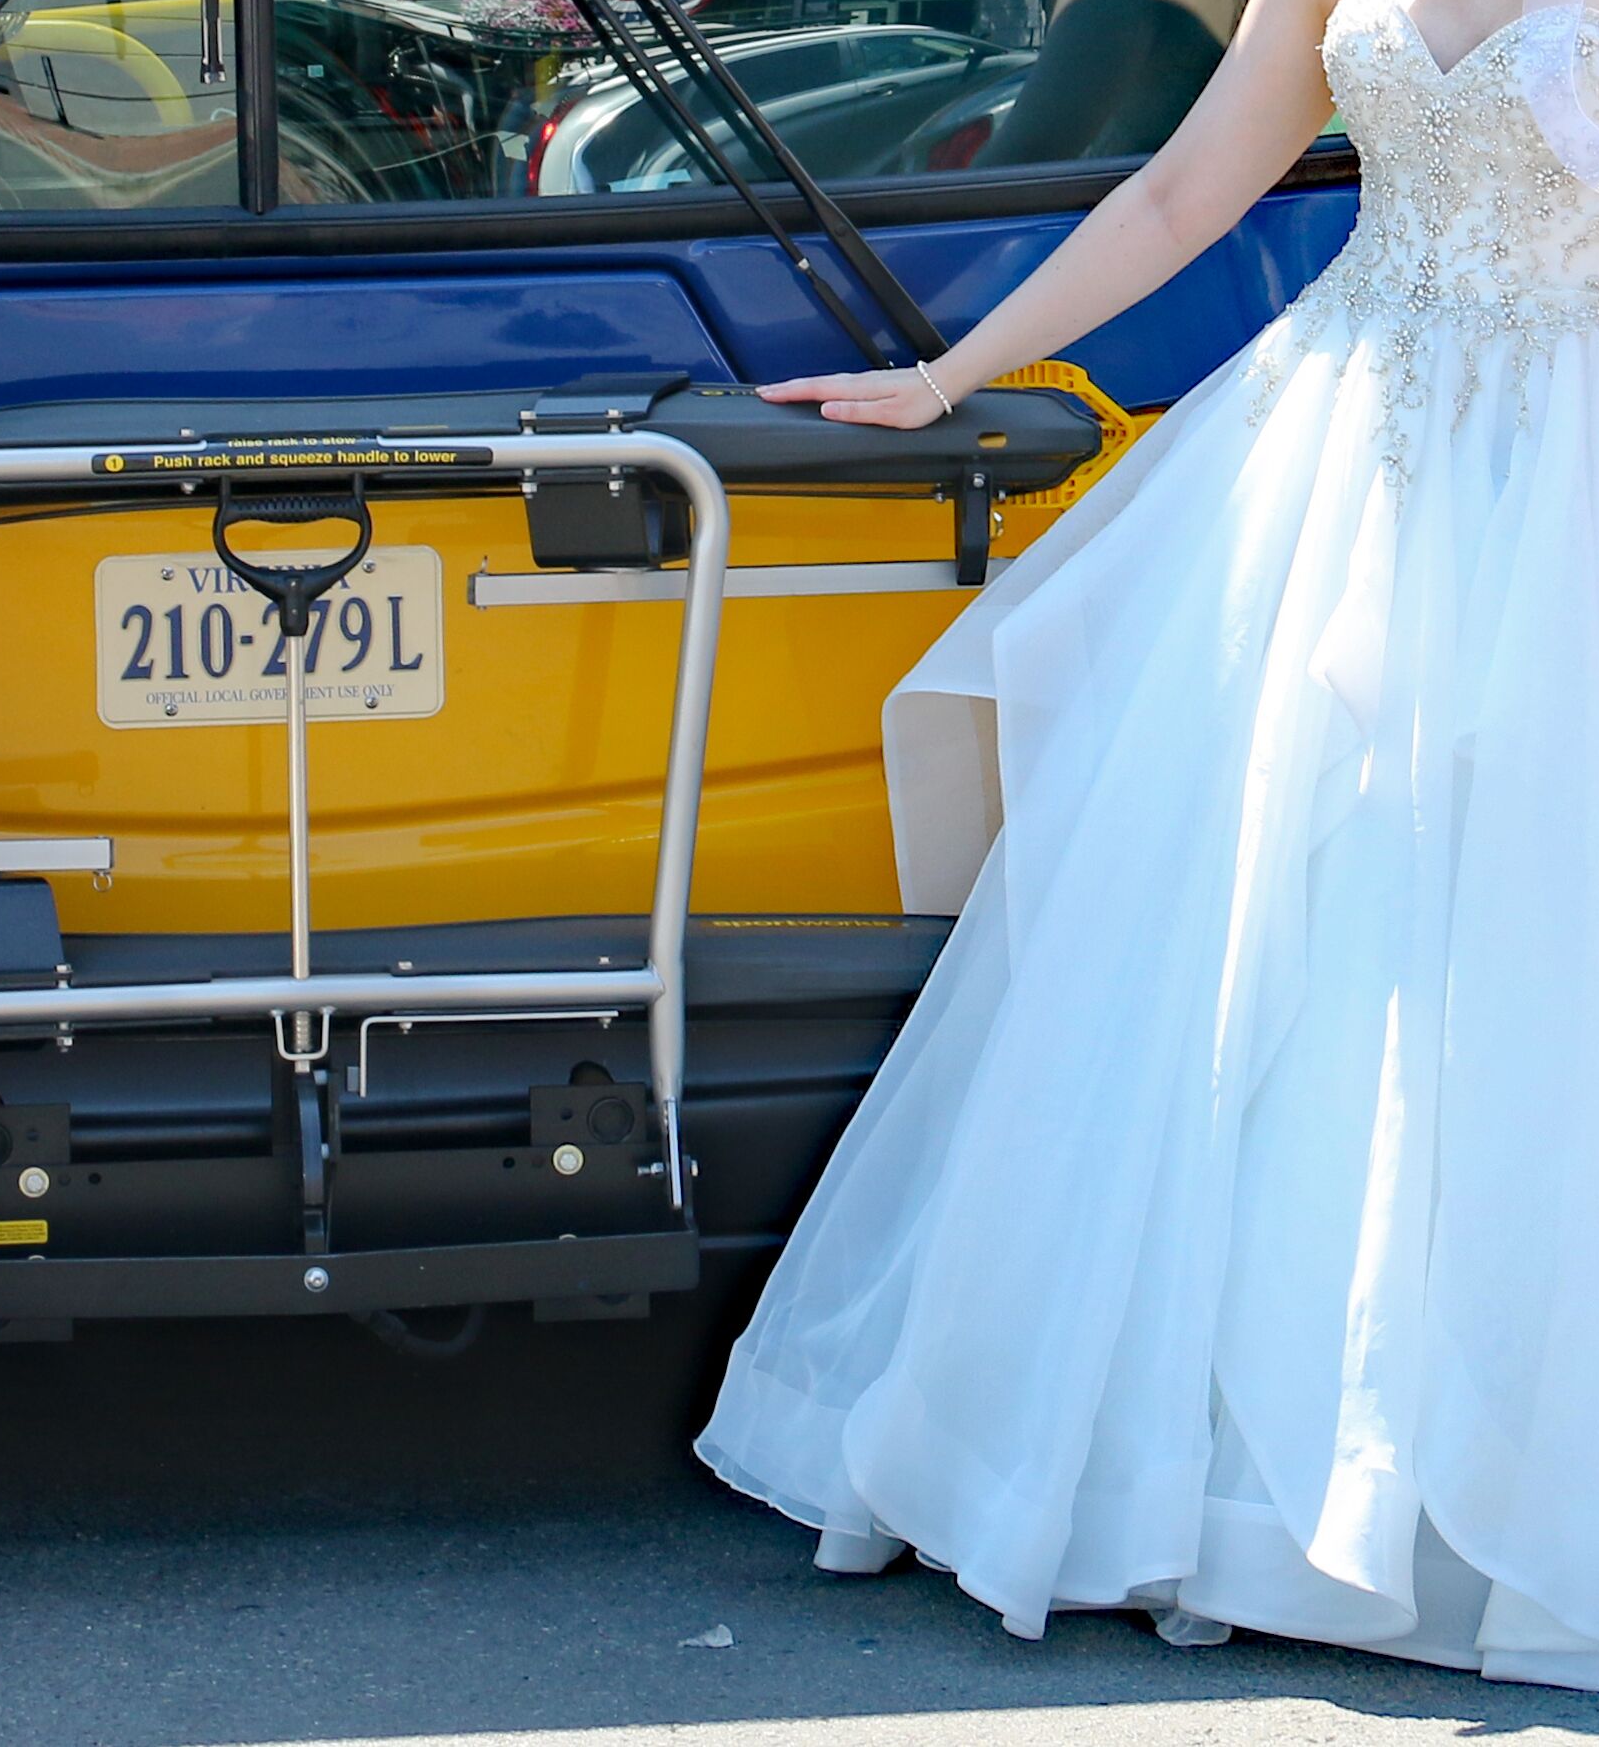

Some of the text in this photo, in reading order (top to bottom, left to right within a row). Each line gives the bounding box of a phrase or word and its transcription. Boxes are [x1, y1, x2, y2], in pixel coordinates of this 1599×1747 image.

[154, 454, 193, 469] Push
[198, 452, 231, 468] rack
[236, 451, 264, 466] and
[270, 452, 333, 467] squeeze
[337, 449, 389, 464] handle
[394, 451, 409, 463] to
[415, 449, 457, 463] lower
[147, 692, 201, 705] OFFICIAL
[206, 690, 247, 703] LOCAL
[338, 685, 360, 698] USE
[363, 683, 395, 698] ONLY
[712, 920, 891, 928] sportworks
